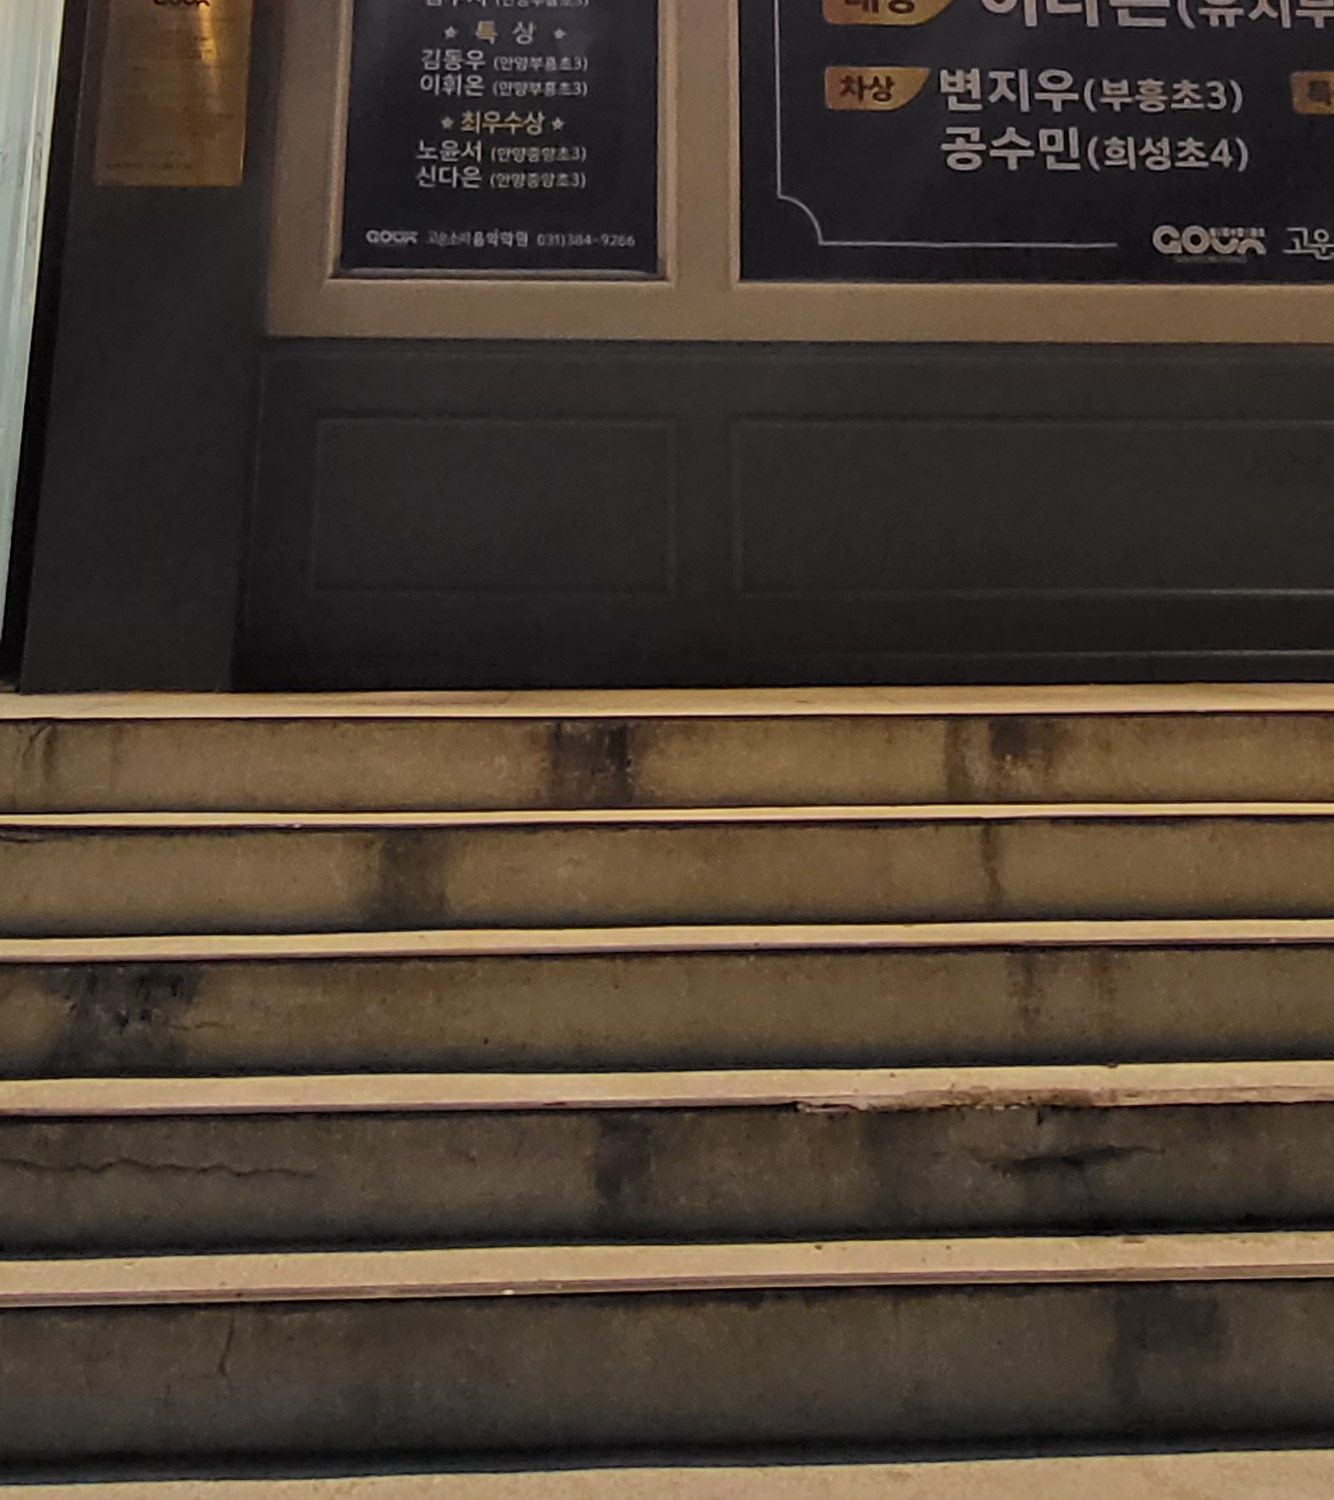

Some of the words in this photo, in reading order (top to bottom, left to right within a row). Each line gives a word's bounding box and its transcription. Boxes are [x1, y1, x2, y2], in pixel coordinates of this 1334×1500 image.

[838, 75, 896, 103] 차상
[460, 110, 546, 136] 최우수상
[416, 140, 483, 163] 노윤서
[416, 164, 483, 189] 신다은
